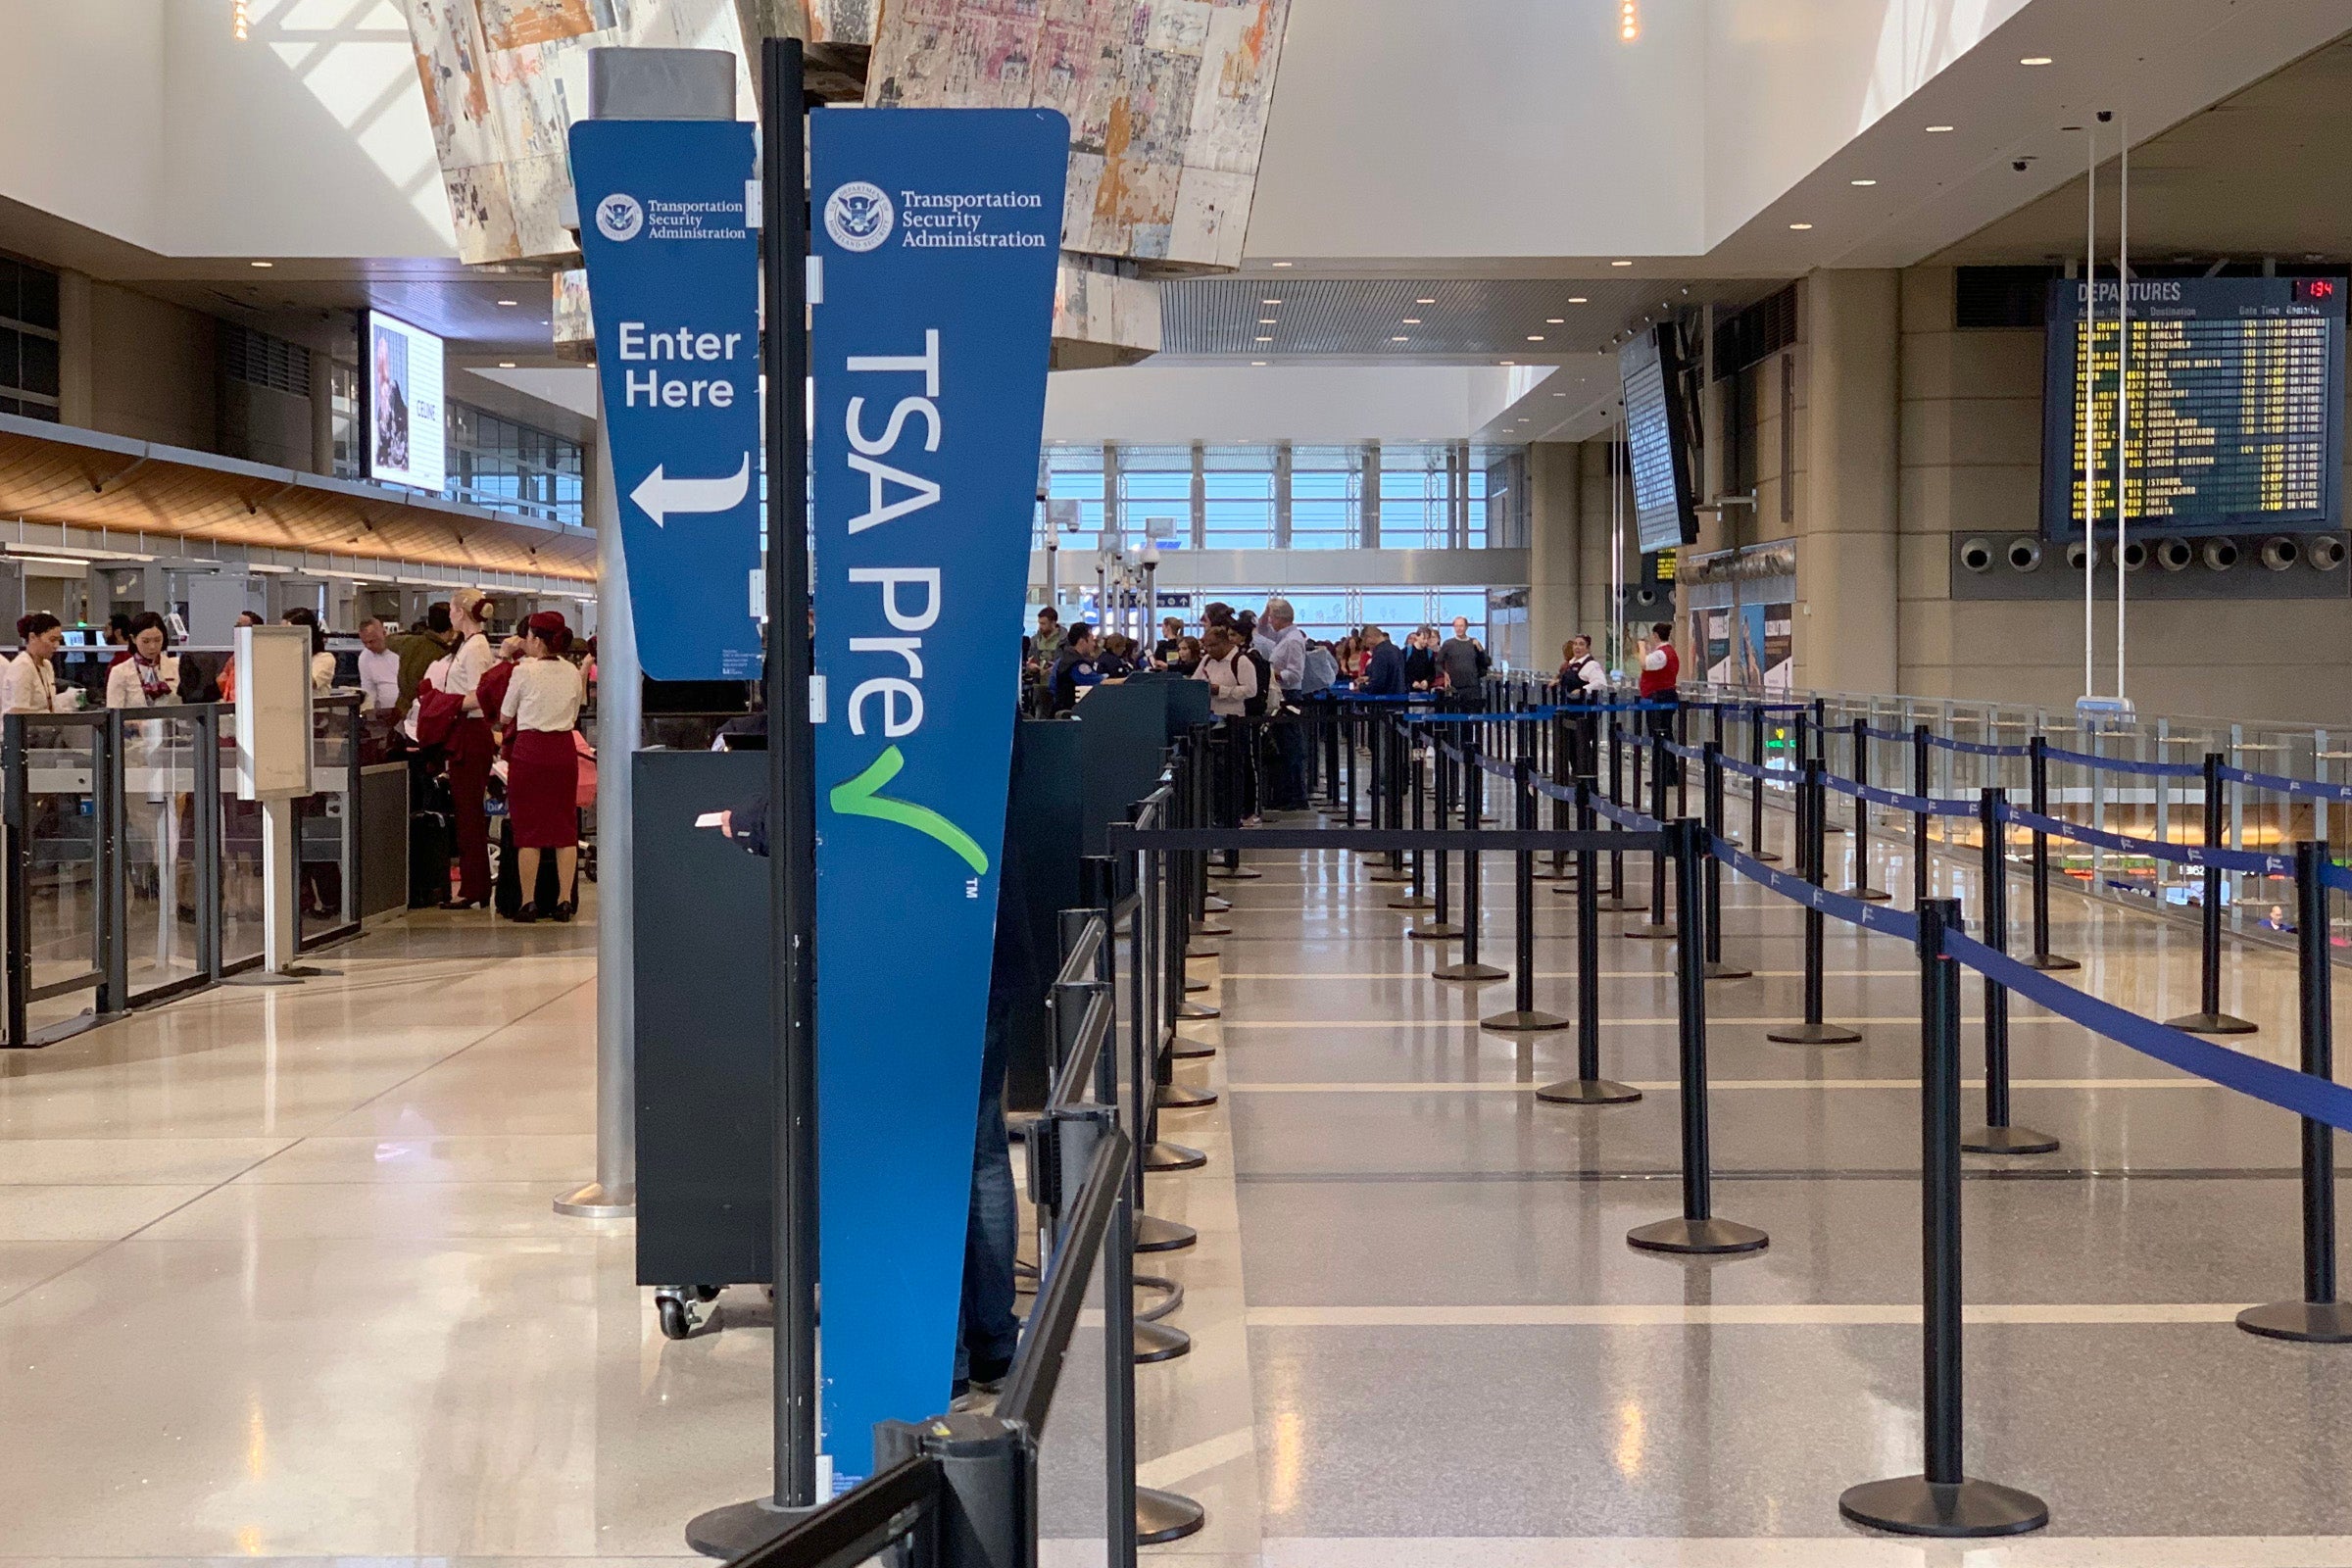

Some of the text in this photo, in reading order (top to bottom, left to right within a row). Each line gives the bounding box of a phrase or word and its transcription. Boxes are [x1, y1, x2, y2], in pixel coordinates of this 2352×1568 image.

[901, 191, 1042, 210] Transportation
[648, 200, 743, 214] Transportation
[648, 214, 703, 227] Security
[903, 211, 981, 229] Security
[648, 226, 747, 240] Administration
[902, 230, 1047, 248] Administration
[619, 322, 741, 360] Enter
[2078, 332, 2110, 341] VOARIS
[2077, 361, 2118, 371] SIGAPORE
[2077, 371, 2100, 381] DETA
[625, 369, 734, 408] Here
[2076, 401, 2112, 412] EMATES
[2076, 411, 2112, 421] AEFLOT
[2076, 420, 2107, 431] VORIS
[846, 329, 941, 534] TSA
[2075, 440, 2111, 451] AMICAN
[2074, 450, 2102, 461] UNED
[2074, 460, 2106, 470] BRISH
[2073, 479, 2110, 490] PAKSTAN
[2073, 489, 2105, 500] VOLRIS
[2073, 499, 2115, 510] NOREGIAN
[2072, 510, 2100, 520] UNIED
[848, 567, 941, 737] Pre
